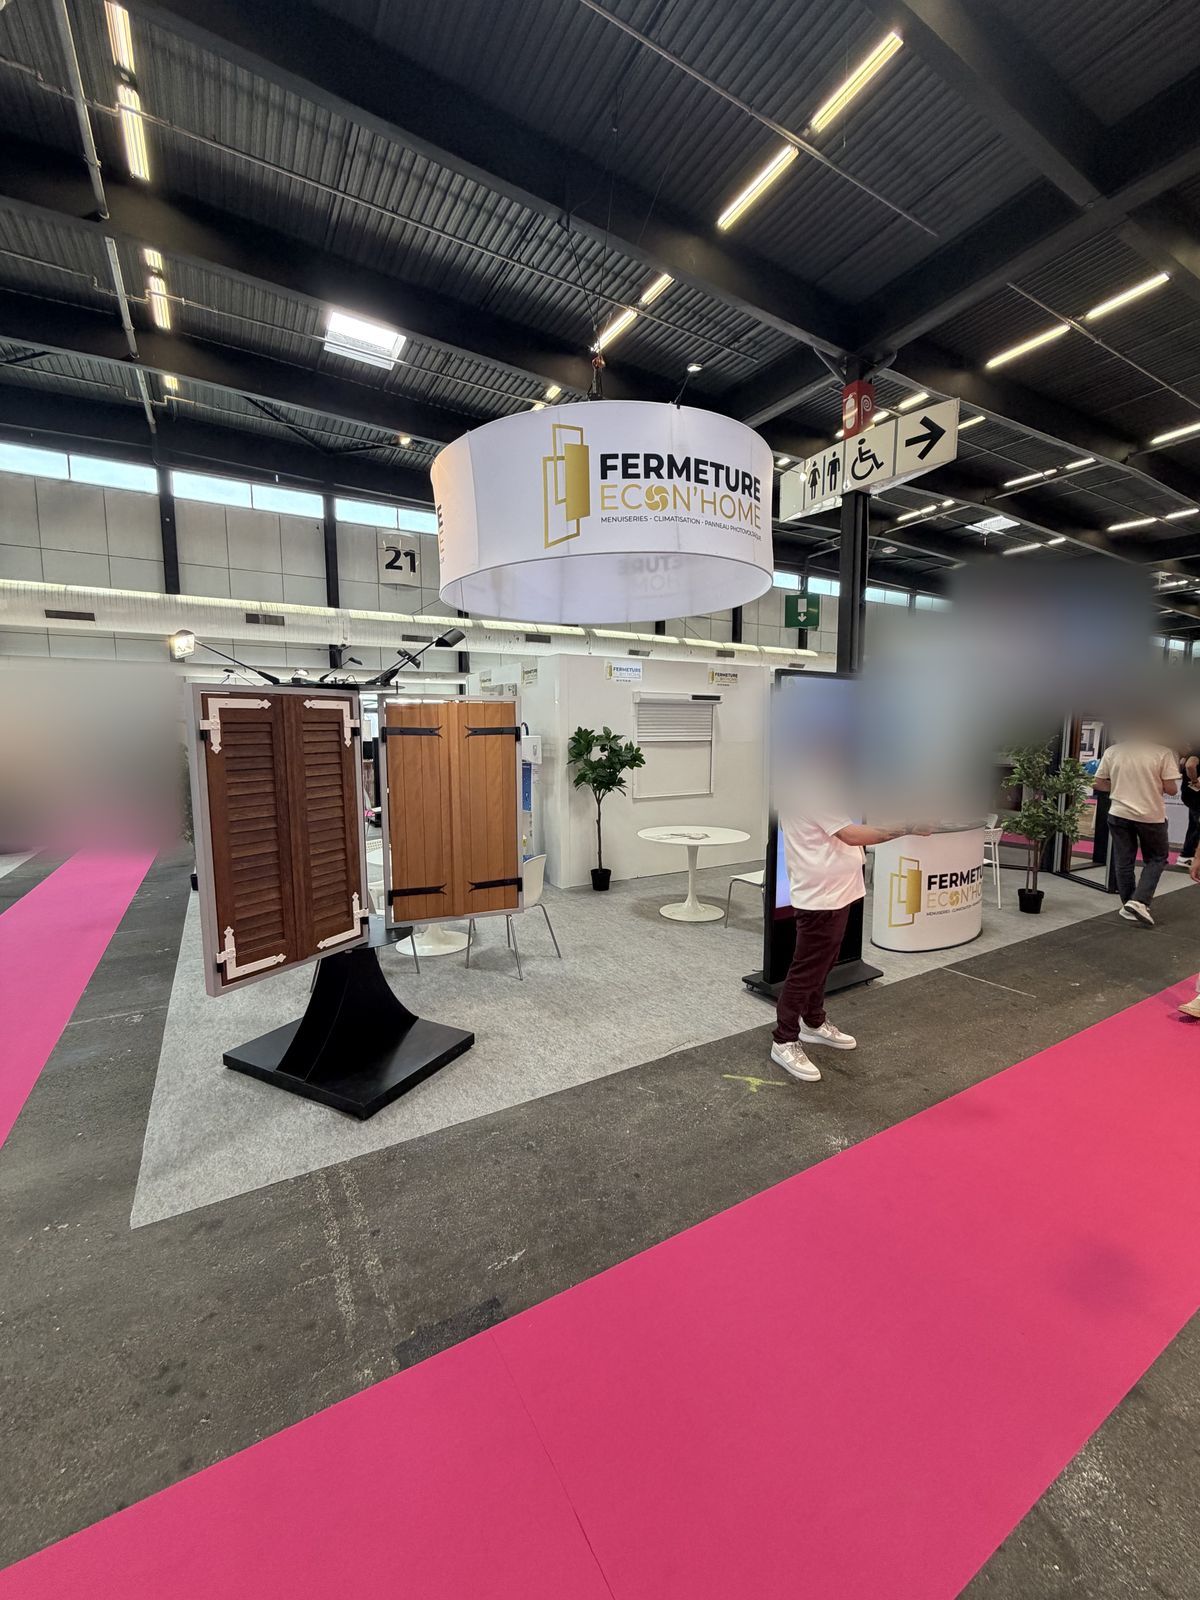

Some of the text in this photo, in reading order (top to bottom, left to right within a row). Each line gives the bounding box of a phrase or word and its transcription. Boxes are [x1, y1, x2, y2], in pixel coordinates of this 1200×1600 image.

[600, 453, 761, 503] FERMETURE
[601, 515, 648, 524] MENUISERIES
[653, 515, 700, 525] CLIMATISATION
[705, 519, 730, 531] PANNEAU
[385, 546, 416, 573] 21
